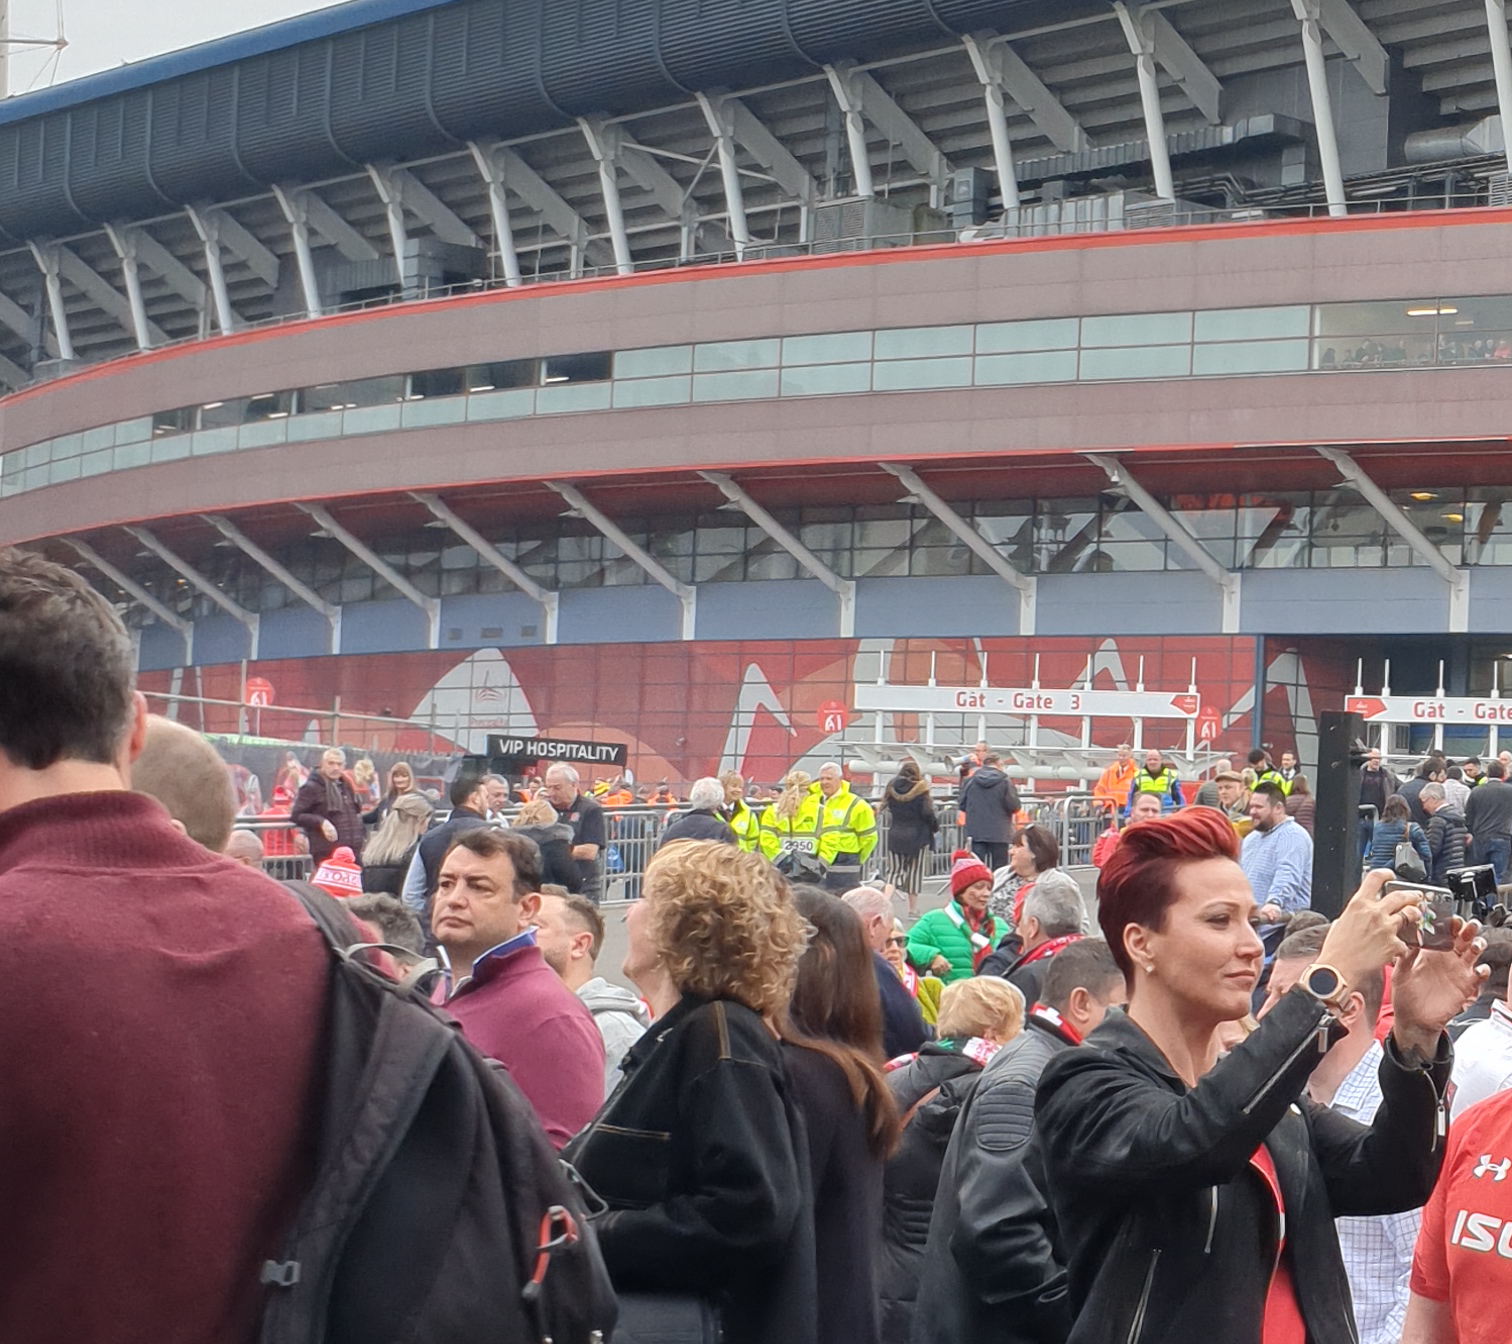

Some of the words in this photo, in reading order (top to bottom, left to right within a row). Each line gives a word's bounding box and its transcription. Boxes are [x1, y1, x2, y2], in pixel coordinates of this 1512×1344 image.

[956, 691, 986, 708] Gât
[1013, 693, 1053, 709] Gate
[1071, 695, 1081, 710] 3
[1413, 701, 1446, 719] Gât
[500, 739, 524, 754] VIP
[527, 742, 619, 761] HOSPITALITY
